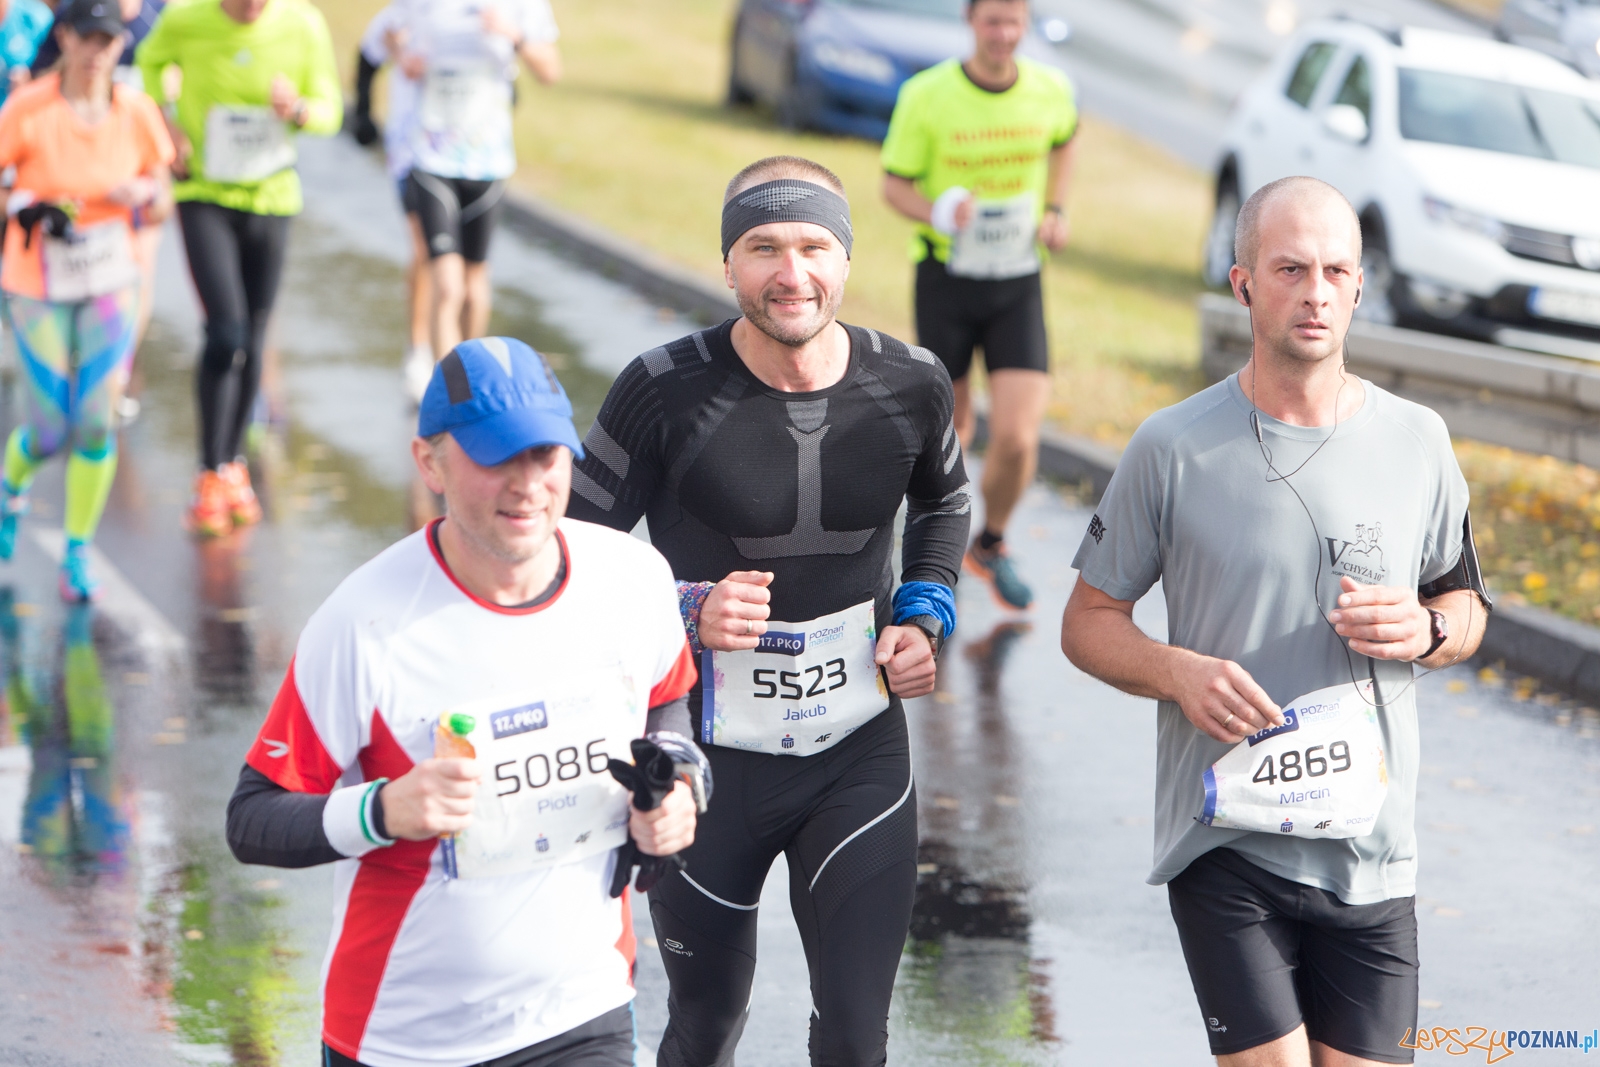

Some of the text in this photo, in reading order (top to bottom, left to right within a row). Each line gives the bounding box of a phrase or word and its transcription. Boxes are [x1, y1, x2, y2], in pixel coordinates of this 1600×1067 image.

[753, 657, 848, 701] 5523
[783, 704, 827, 721] Jakub
[494, 738, 610, 797] 5086
[1252, 740, 1351, 785] 4869
[537, 792, 578, 814] Piotr
[1279, 787, 1330, 804] Marcin
